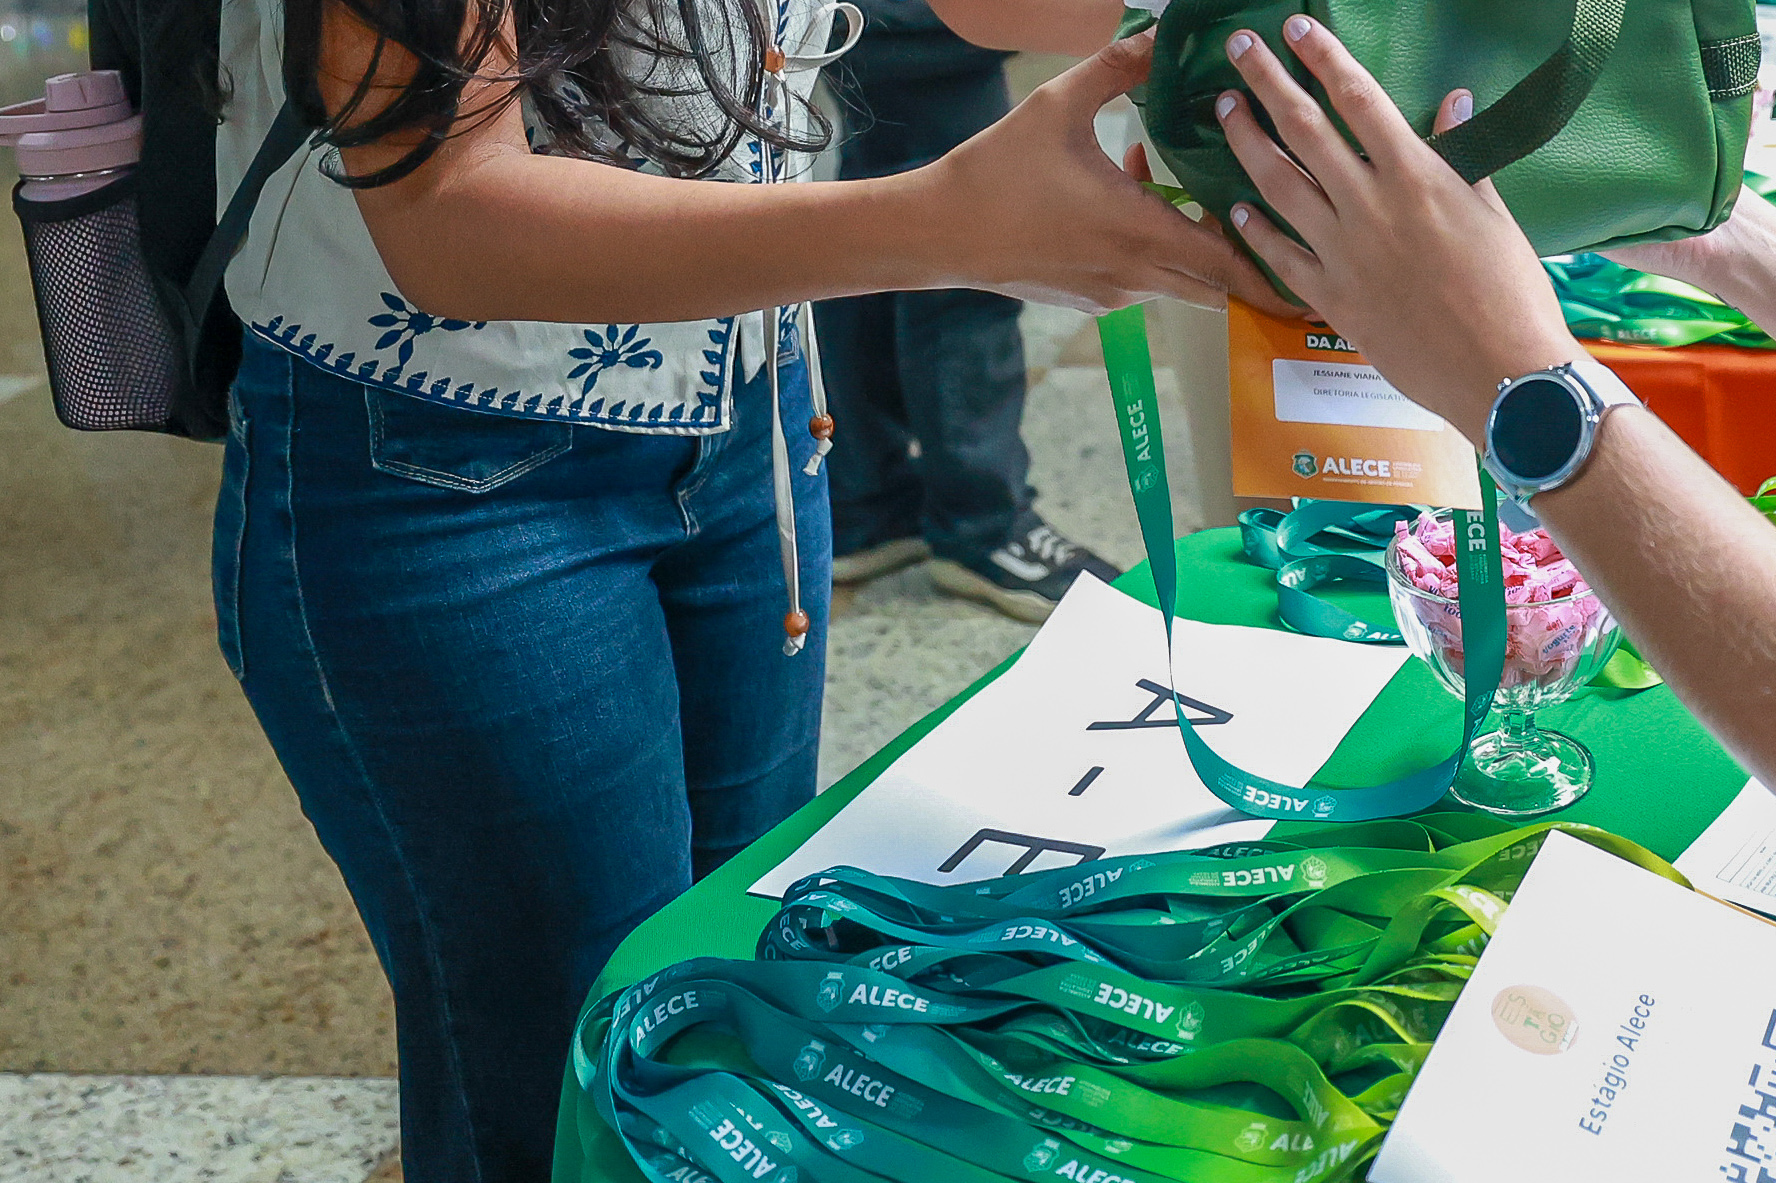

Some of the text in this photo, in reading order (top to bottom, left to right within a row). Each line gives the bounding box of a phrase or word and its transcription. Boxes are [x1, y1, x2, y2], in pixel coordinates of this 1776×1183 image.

[1306, 335, 1331, 348] DA
[1126, 399, 1151, 462] ALECE
[1322, 456, 1391, 477] ALECE
[1243, 785, 1310, 812] ALECE
[1059, 868, 1124, 908] ALECE
[1222, 864, 1295, 887] ALECE
[1002, 925, 1077, 946] ALECE
[848, 983, 930, 1013] ALECE
[1094, 982, 1175, 1024] ALECE
[635, 990, 699, 1049] ALECE
[1578, 993, 1656, 1136] Estágio Alece
[824, 1063, 895, 1108] ALECE
[1003, 1072, 1076, 1096] ALECE
[709, 1118, 777, 1179] ALECE
